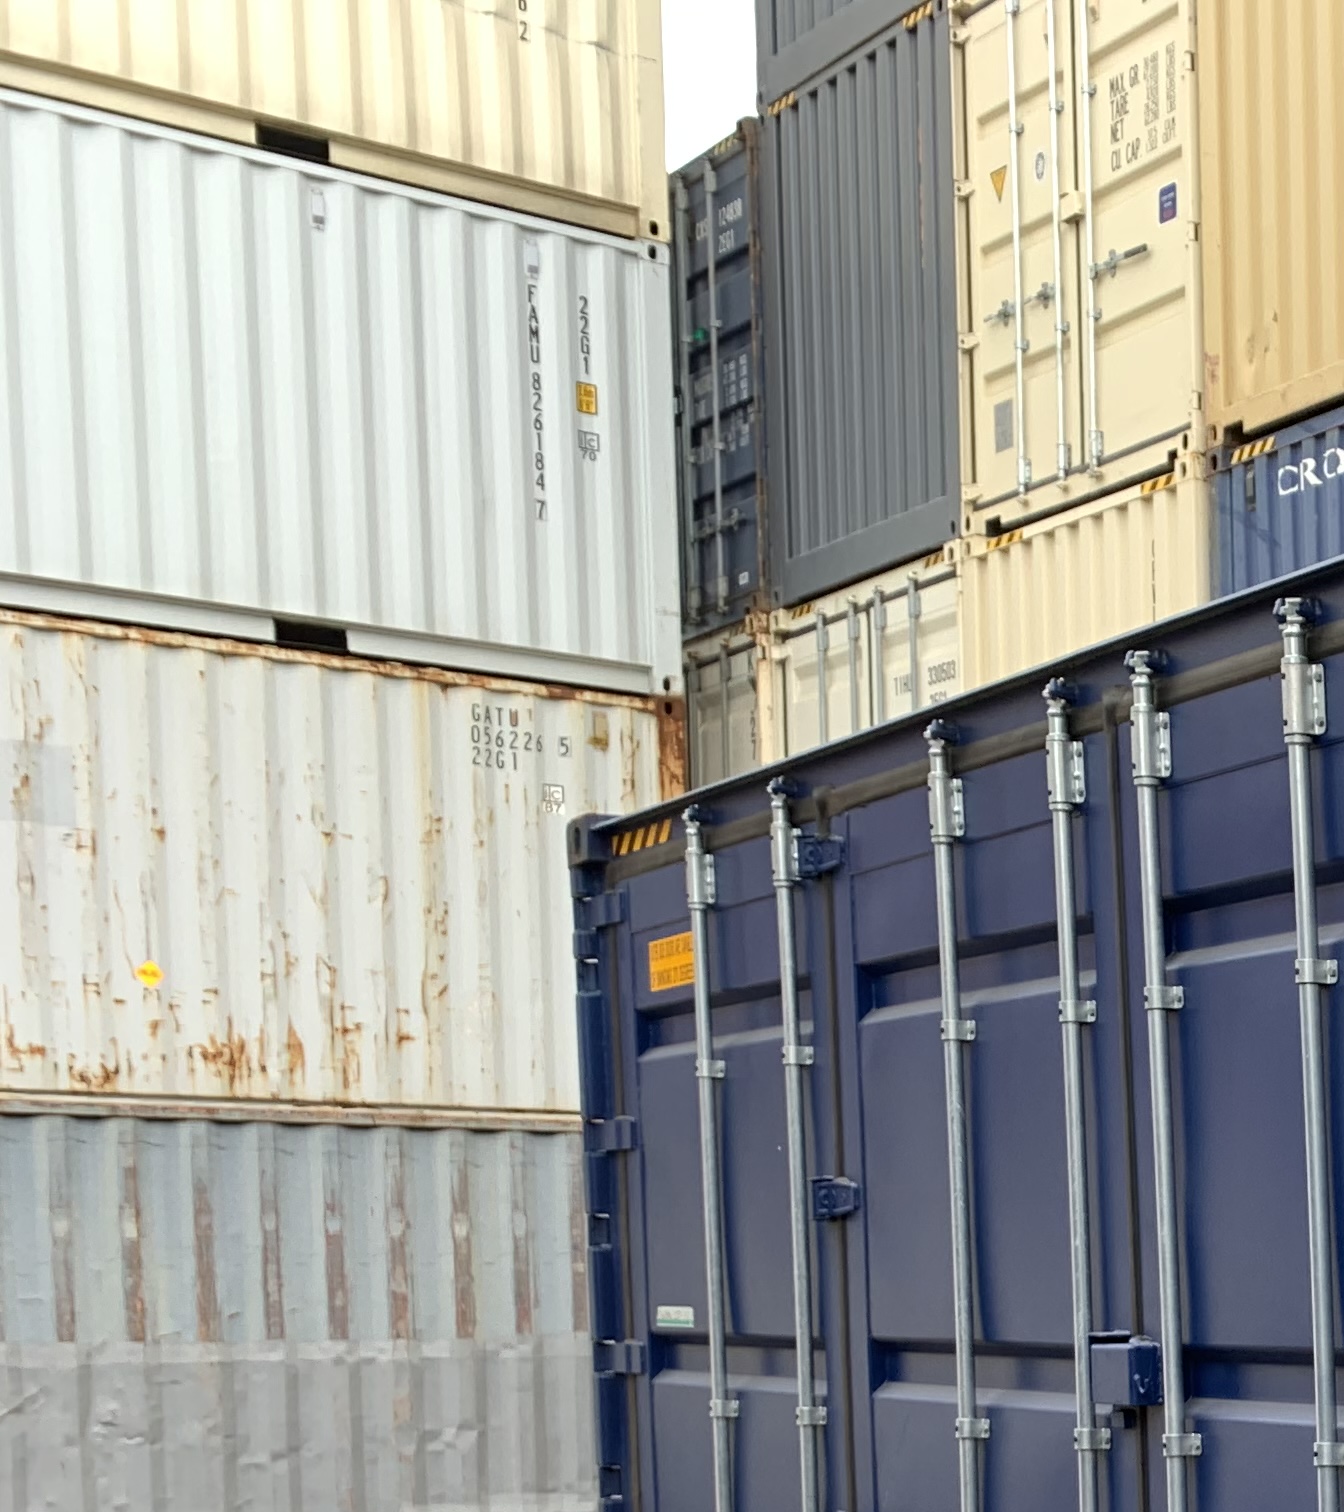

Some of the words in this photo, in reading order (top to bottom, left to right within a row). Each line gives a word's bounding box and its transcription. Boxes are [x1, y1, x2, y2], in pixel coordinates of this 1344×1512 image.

[526, 284, 541, 364] FAMU
[579, 296, 590, 375] 22G1
[532, 371, 546, 491] 826184
[535, 499, 546, 520] 7
[471, 703, 519, 728] GATU
[470, 724, 544, 753] 056226
[471, 746, 518, 771] 22G1
